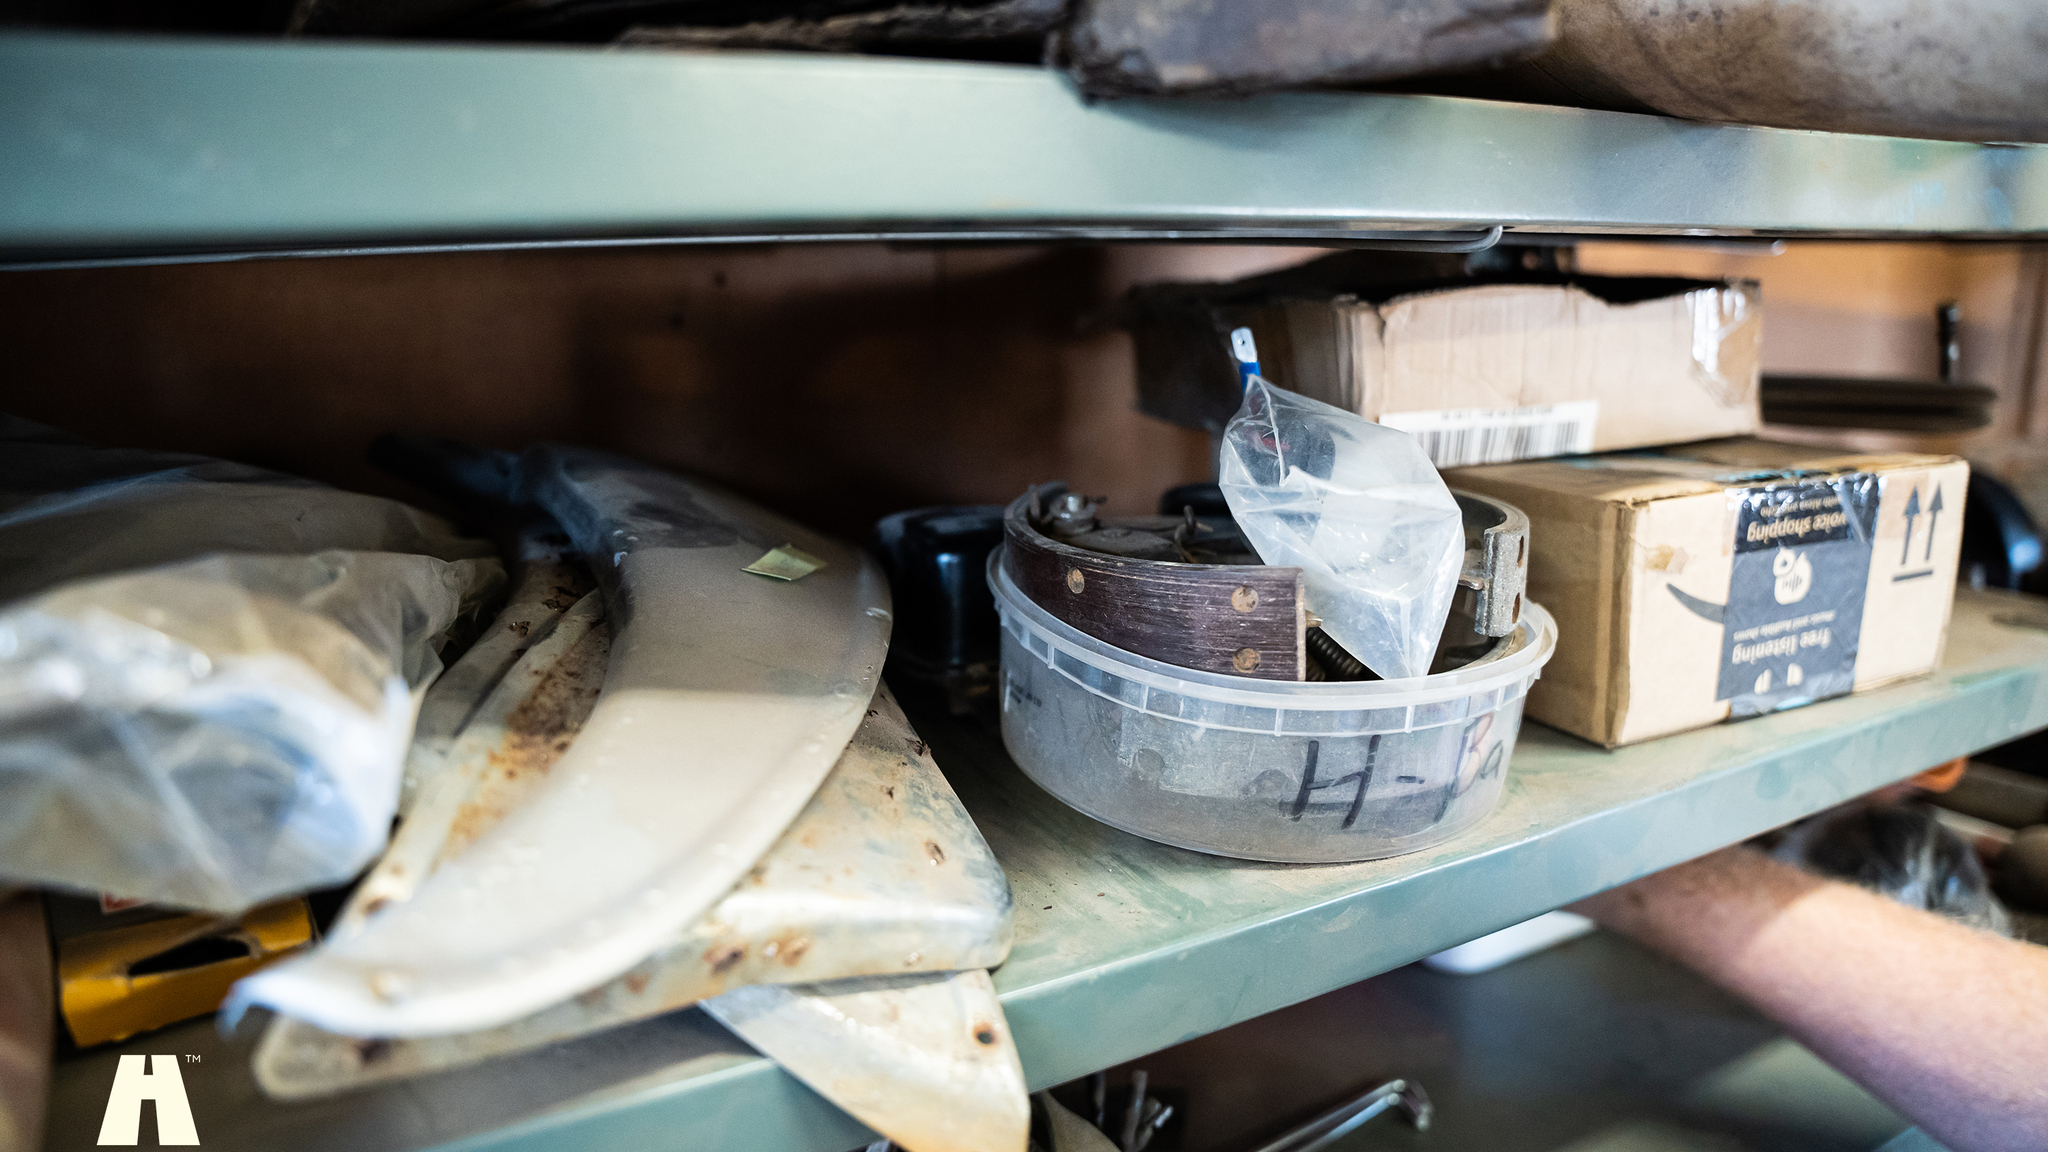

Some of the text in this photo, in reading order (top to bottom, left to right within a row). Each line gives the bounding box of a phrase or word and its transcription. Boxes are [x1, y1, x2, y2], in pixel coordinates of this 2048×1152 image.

[1800, 498, 1821, 511] Alexa
[1747, 512, 1847, 544] voice shopping
[1733, 626, 1760, 642] shows
[1760, 619, 1792, 636] Audible
[1732, 627, 1832, 665] free listening
